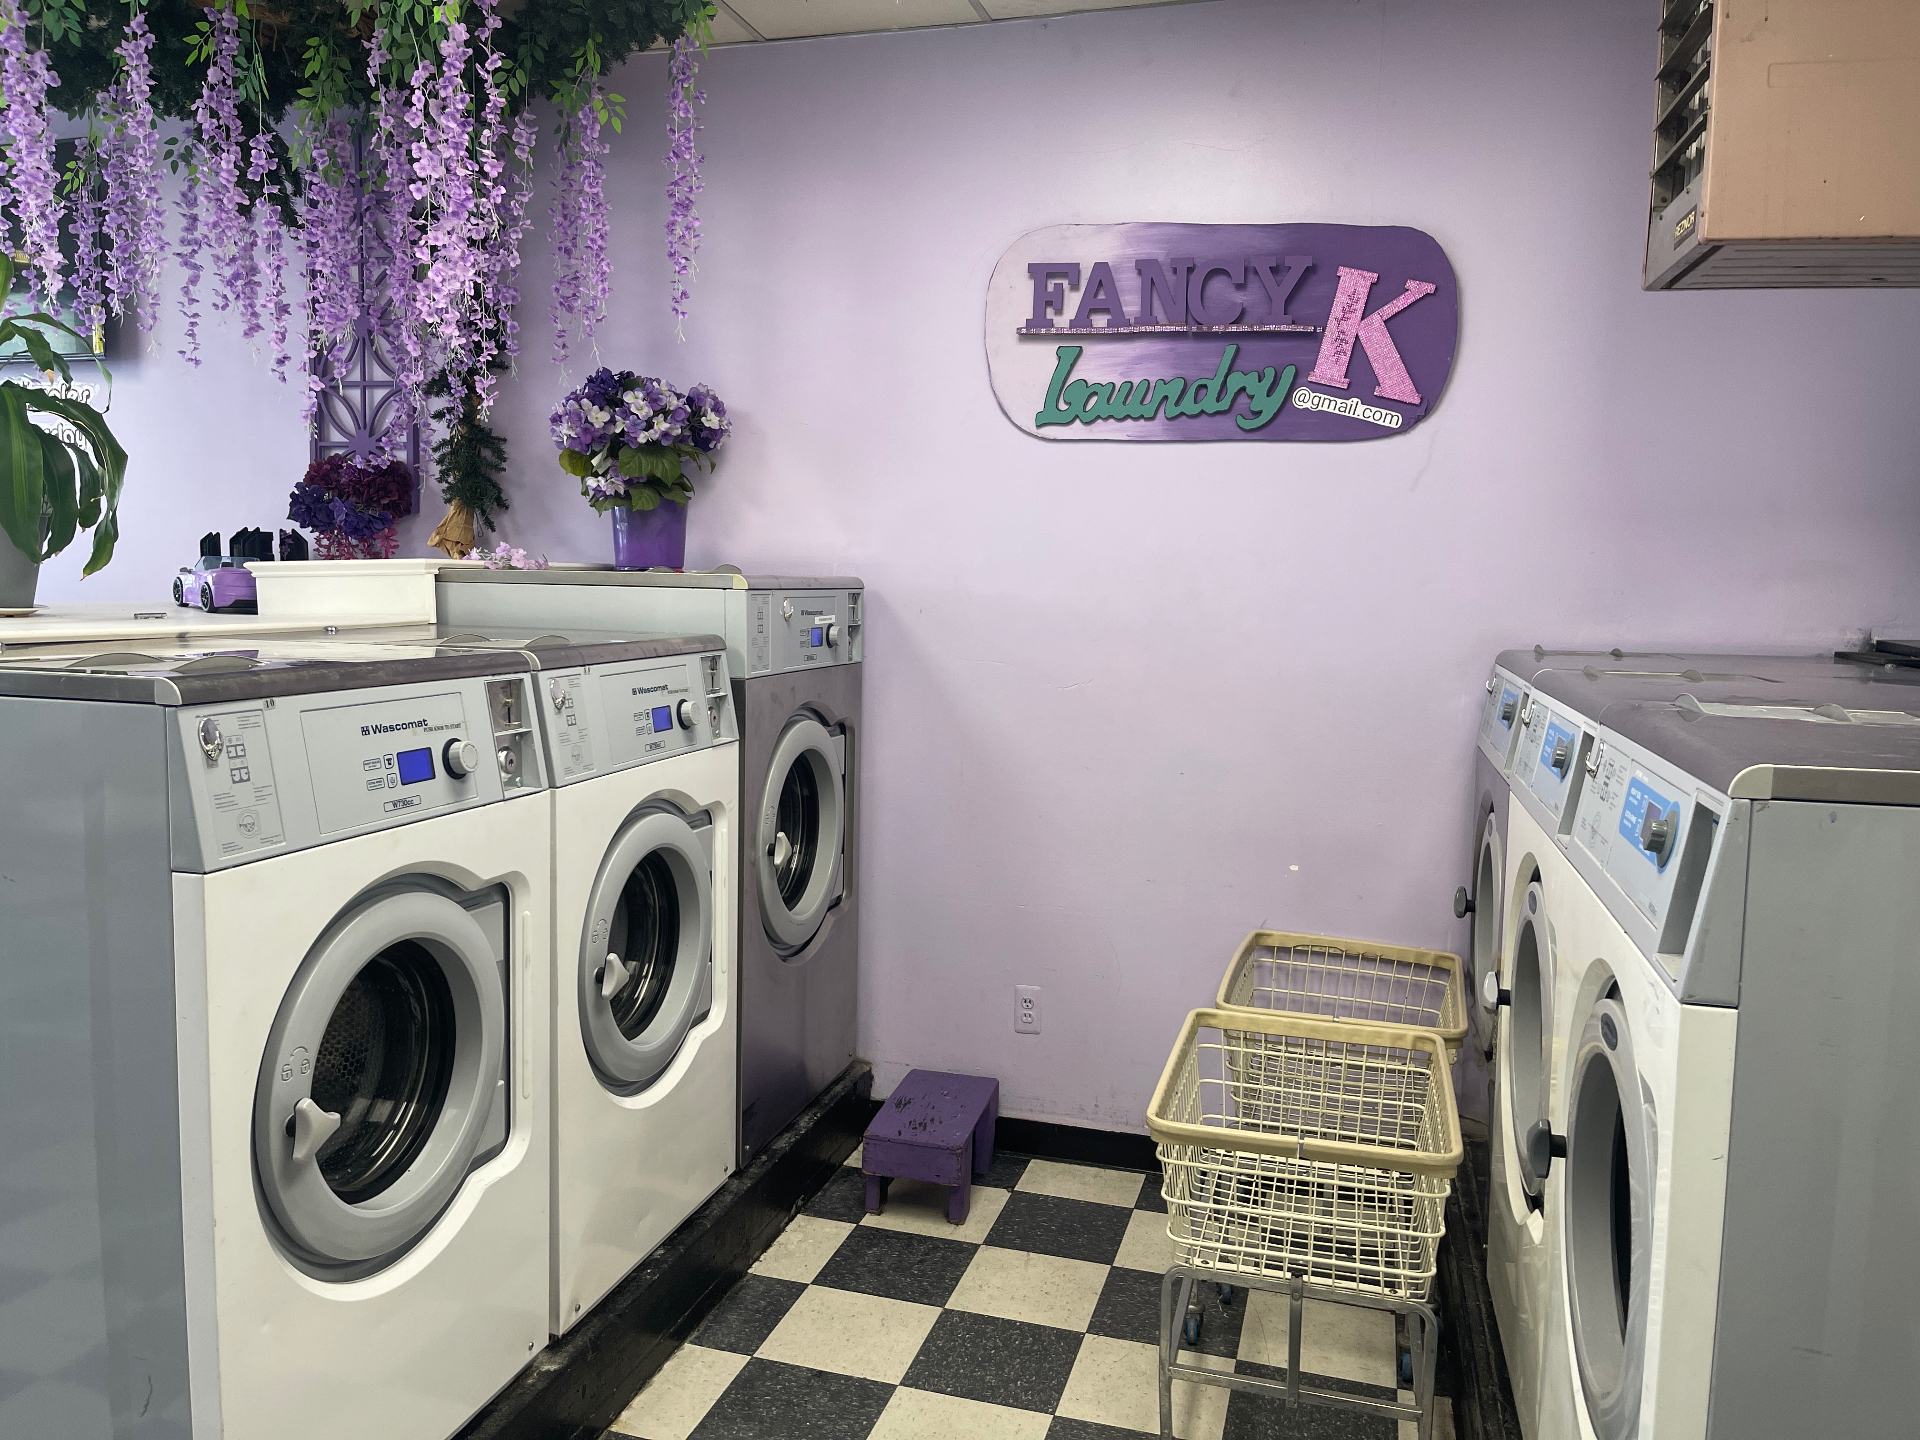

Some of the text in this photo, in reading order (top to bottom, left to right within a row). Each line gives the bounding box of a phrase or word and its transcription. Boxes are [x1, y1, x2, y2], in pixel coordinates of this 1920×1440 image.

[1026, 255, 1313, 327] FANCY
[1308, 266, 1437, 404] K
[1036, 344, 1297, 430] Laundry
[1294, 388, 1401, 427] @gmail.com
[265, 699, 275, 708] 10
[637, 684, 669, 695] Wascomat
[371, 718, 429, 735] Wascomat
